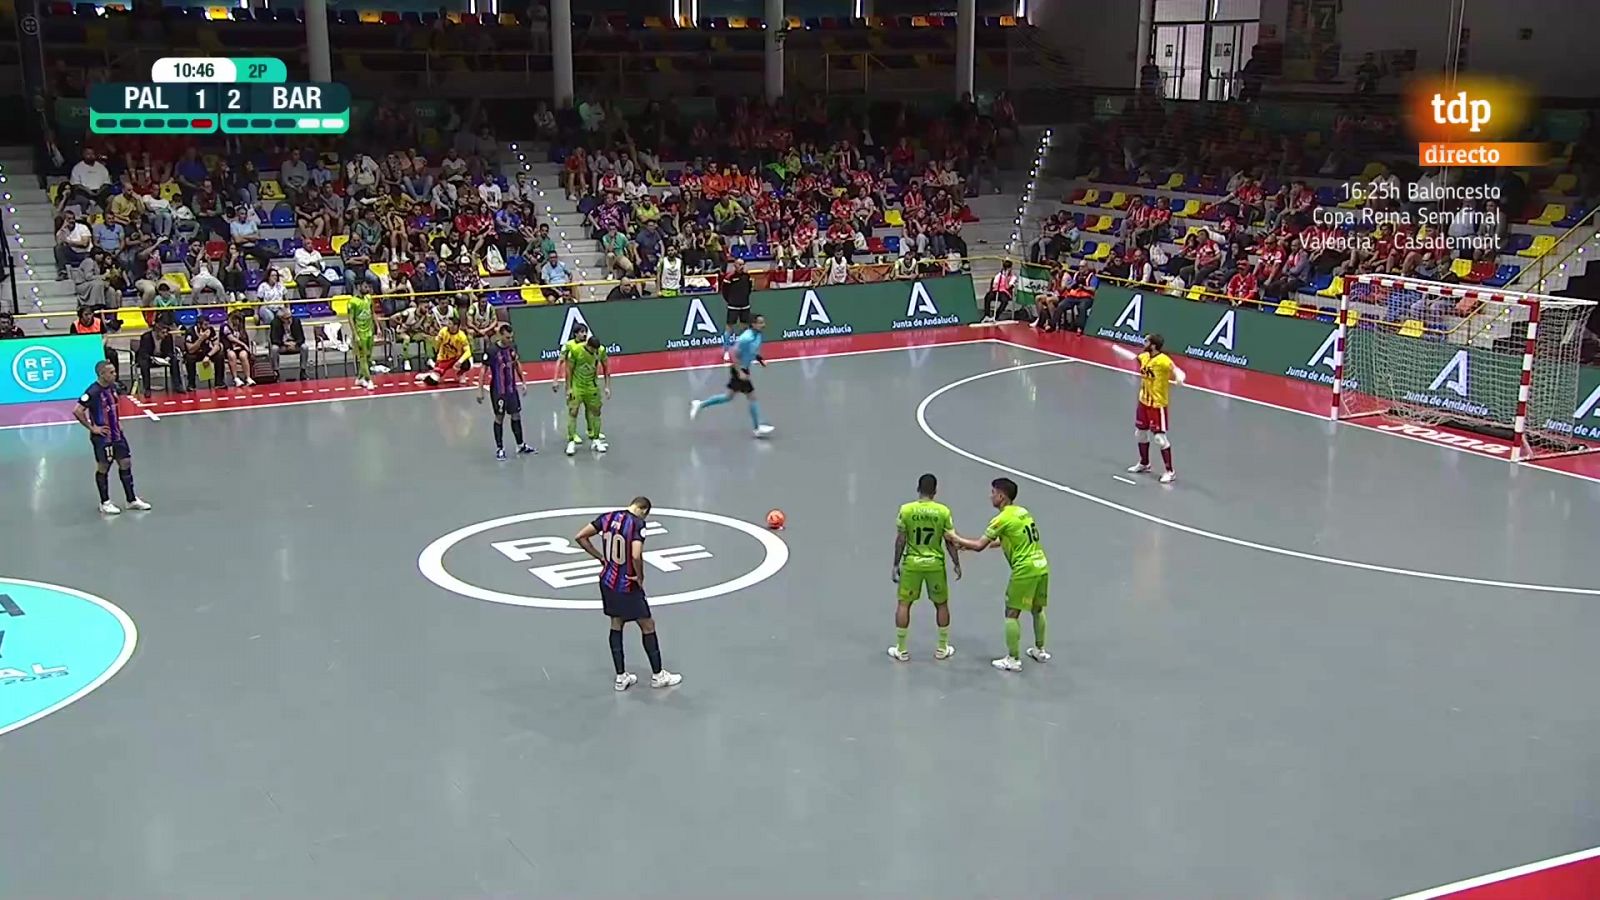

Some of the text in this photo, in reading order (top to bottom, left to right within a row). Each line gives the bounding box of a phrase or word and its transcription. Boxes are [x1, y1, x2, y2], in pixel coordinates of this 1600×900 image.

[892, 314, 959, 329] Junta de Andalucía
[783, 323, 852, 338] Junta de Andalucía
[1097, 327, 1115, 338] Junta
[1114, 330, 1123, 340] de
[667, 339, 690, 348] Junta
[690, 337, 701, 346] de
[541, 349, 562, 359] Junt
[1185, 345, 1248, 366] Junta de Andalucía
[1286, 366, 1358, 389] Junta de Anducía
[1402, 390, 1489, 415] Junta de Andalucía
[1542, 418, 1574, 433] Junta
[1574, 424, 1589, 435] de
[913, 527, 935, 545] 17
[603, 531, 626, 565] 10
